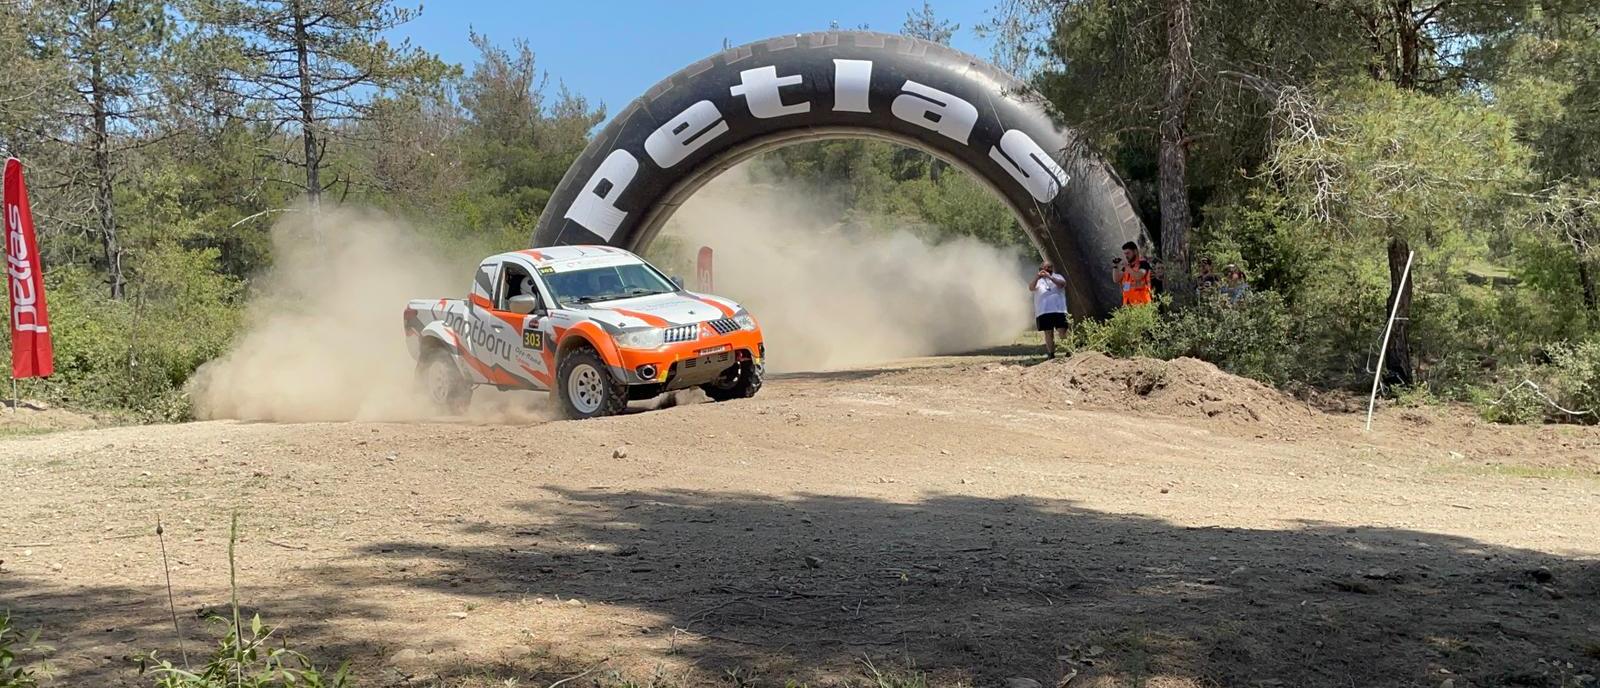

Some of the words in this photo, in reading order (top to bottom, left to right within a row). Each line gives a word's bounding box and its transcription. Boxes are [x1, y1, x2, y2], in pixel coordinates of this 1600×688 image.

[8, 203, 47, 333] petlas
[443, 304, 512, 361] bantboru
[524, 332, 541, 347] 303
